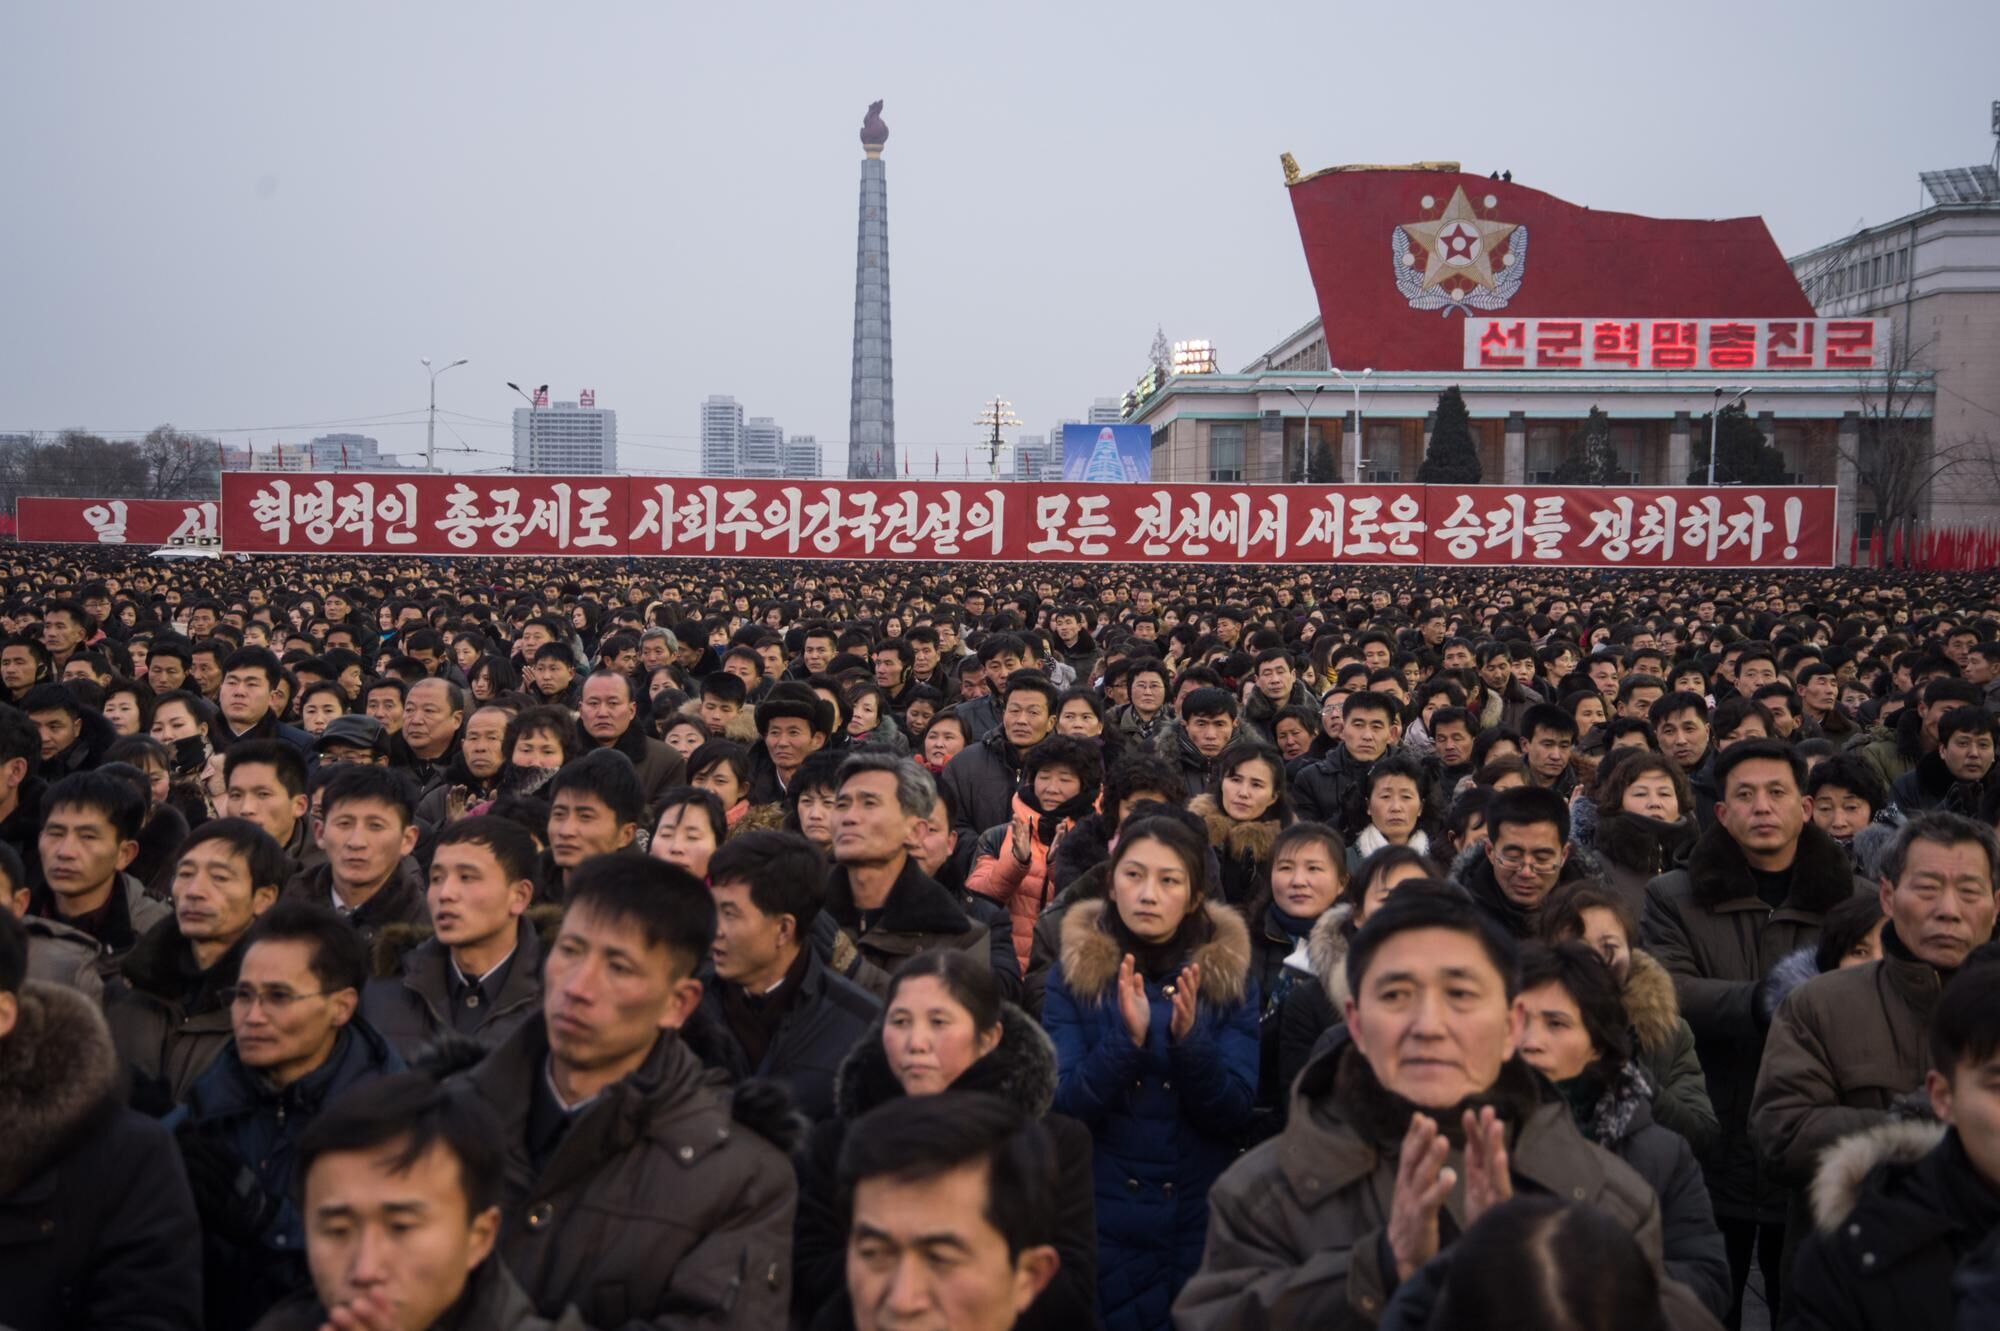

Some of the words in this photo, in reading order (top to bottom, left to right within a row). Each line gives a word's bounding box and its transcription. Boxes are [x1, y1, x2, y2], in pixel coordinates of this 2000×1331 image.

[1479, 321, 1875, 367] 선군혁명총진군
[249, 479, 418, 547] 혁명적인
[434, 482, 618, 549] 총공세로
[628, 483, 1006, 555] 사회주의강국건설의
[1027, 492, 1117, 556] 모든
[1126, 490, 1289, 558] 전선에서
[1295, 492, 1428, 558] 새로운
[1434, 493, 1572, 560] 승리를
